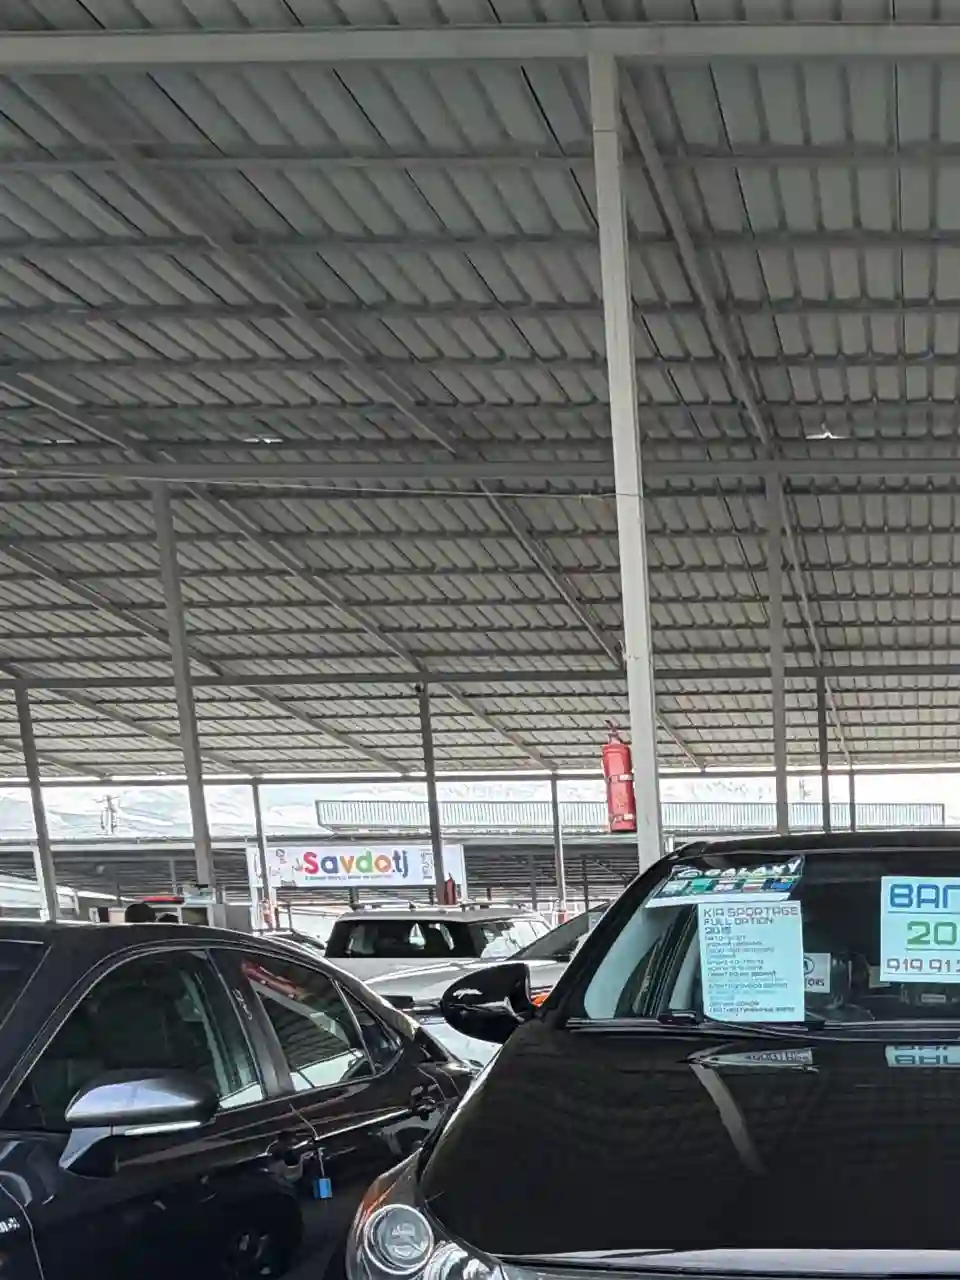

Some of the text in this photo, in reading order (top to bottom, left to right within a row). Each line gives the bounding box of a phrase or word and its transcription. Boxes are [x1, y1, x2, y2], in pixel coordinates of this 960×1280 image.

[303, 850, 409, 878] Savdo.tj
[703, 906, 799, 917] KIA SPORTAGE
[703, 917, 732, 926] FULL
[886, 958, 923, 973] 919
[928, 958, 951, 973] 91
